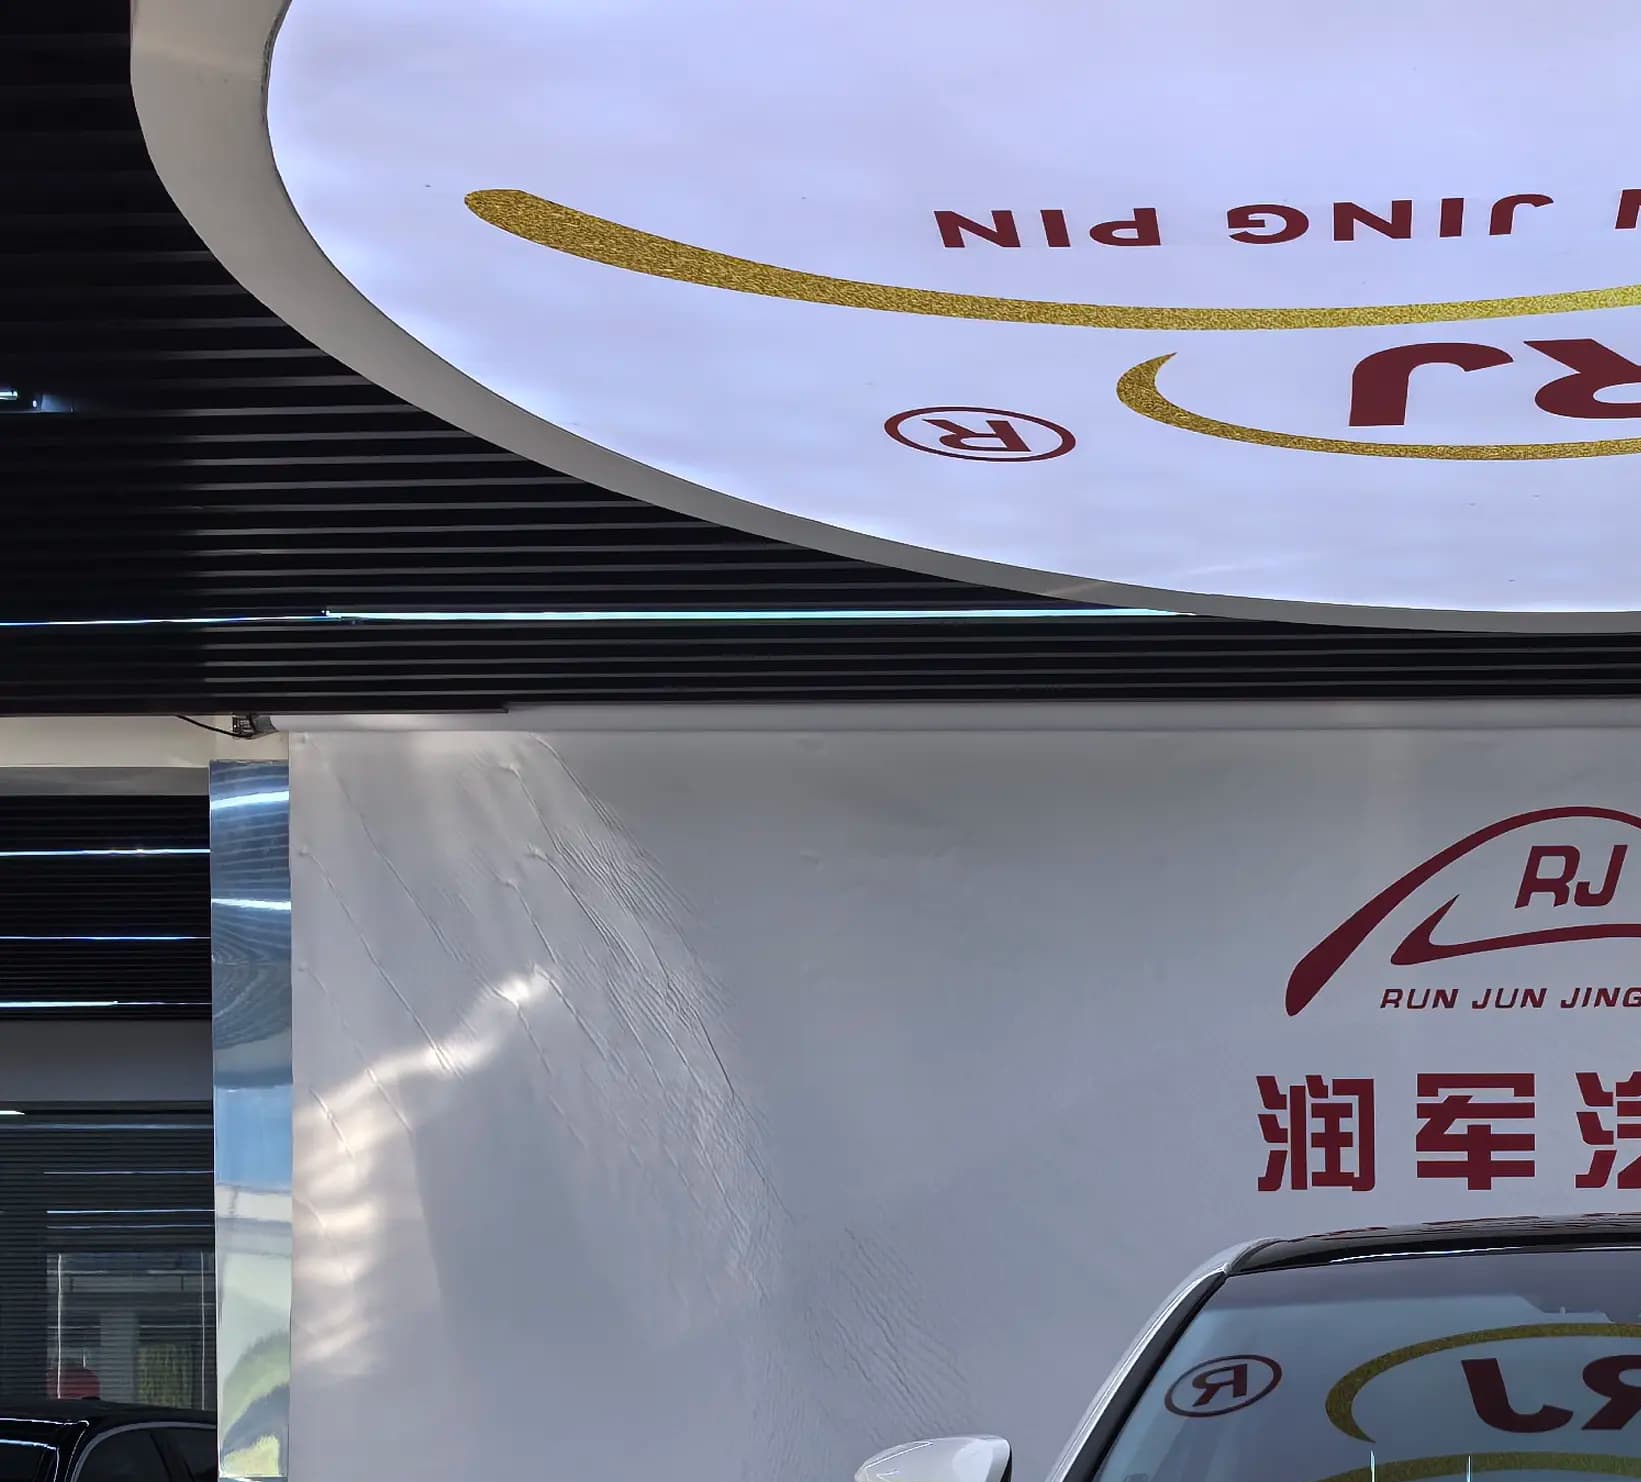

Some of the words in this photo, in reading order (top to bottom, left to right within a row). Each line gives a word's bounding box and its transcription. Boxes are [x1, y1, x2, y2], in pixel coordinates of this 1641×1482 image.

[935, 207, 1162, 249] PIN
[1227, 193, 1552, 245] JING
[1515, 844, 1628, 909] RJ
[1380, 988, 1459, 1010] RUN
[1472, 987, 1547, 1009] JUN
